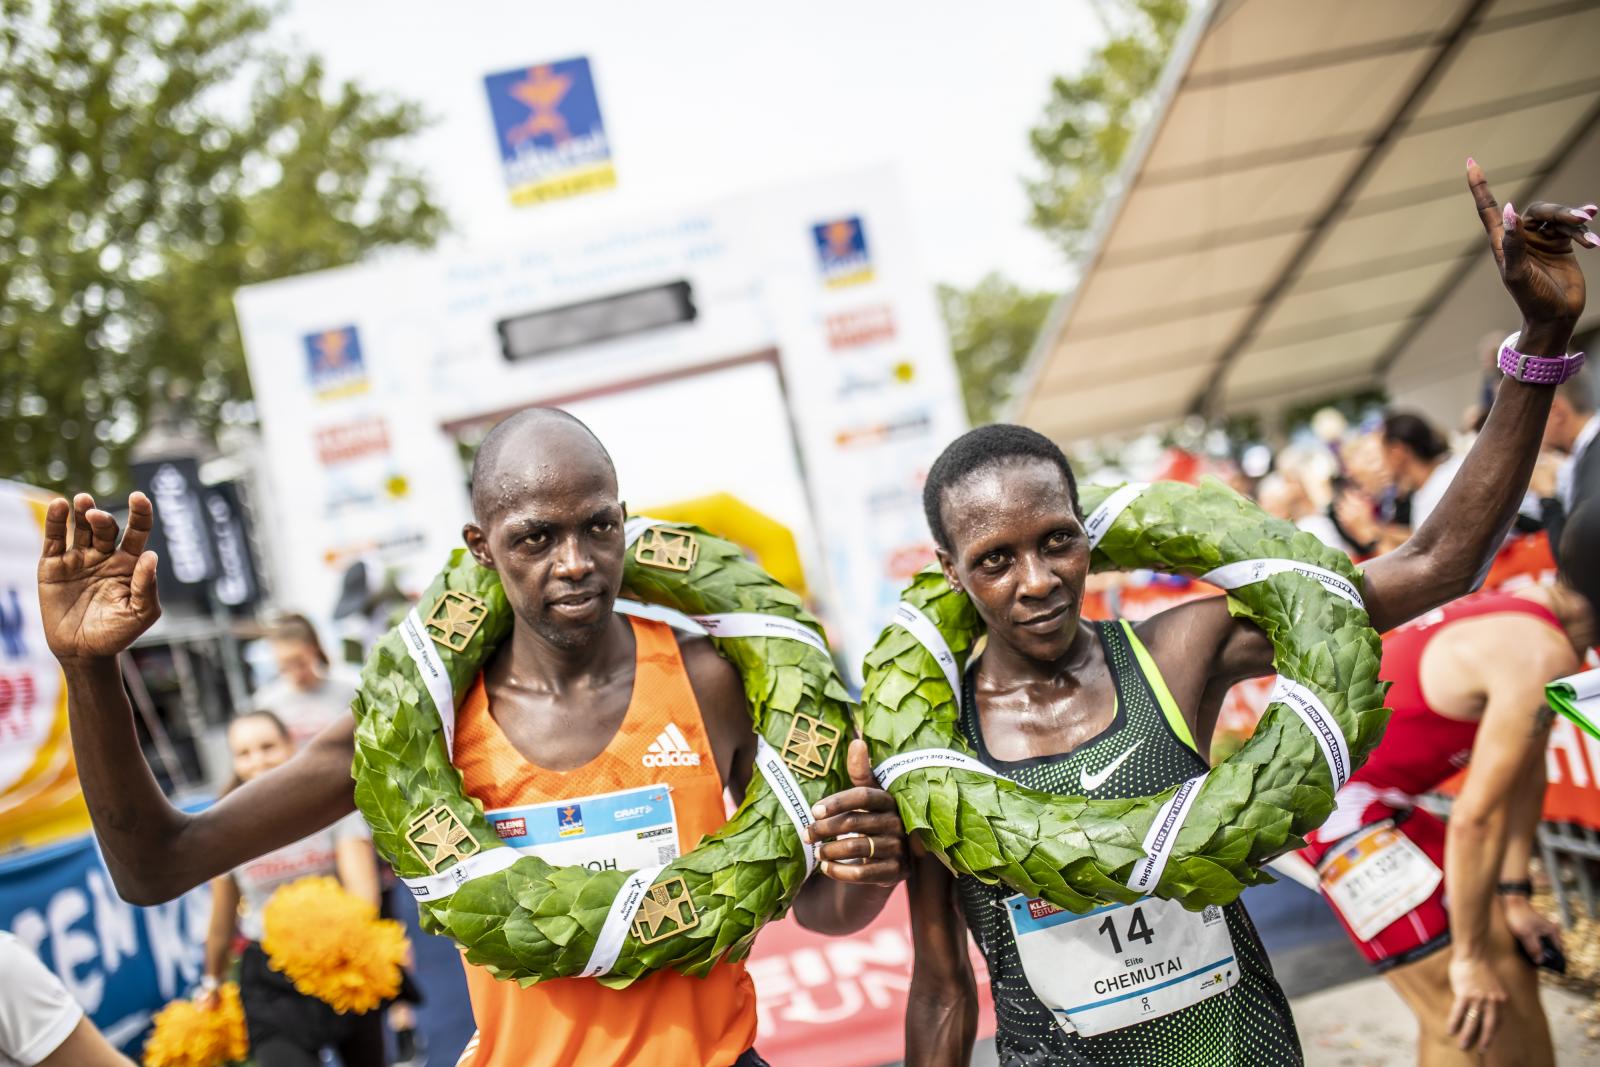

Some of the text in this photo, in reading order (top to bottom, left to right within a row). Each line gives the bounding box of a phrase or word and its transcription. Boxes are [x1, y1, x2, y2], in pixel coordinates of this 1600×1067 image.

[1305, 705, 1320, 722] UND
[1316, 720, 1329, 735] DIE
[1325, 733, 1344, 780] BADEHOSE
[642, 751, 701, 768] adidas
[1153, 830, 1167, 850] 2019
[1138, 853, 1157, 886] FINISHER
[1098, 907, 1154, 953] 14
[1094, 956, 1182, 994] CHEMUTAI
[1125, 957, 1144, 968] Elite
